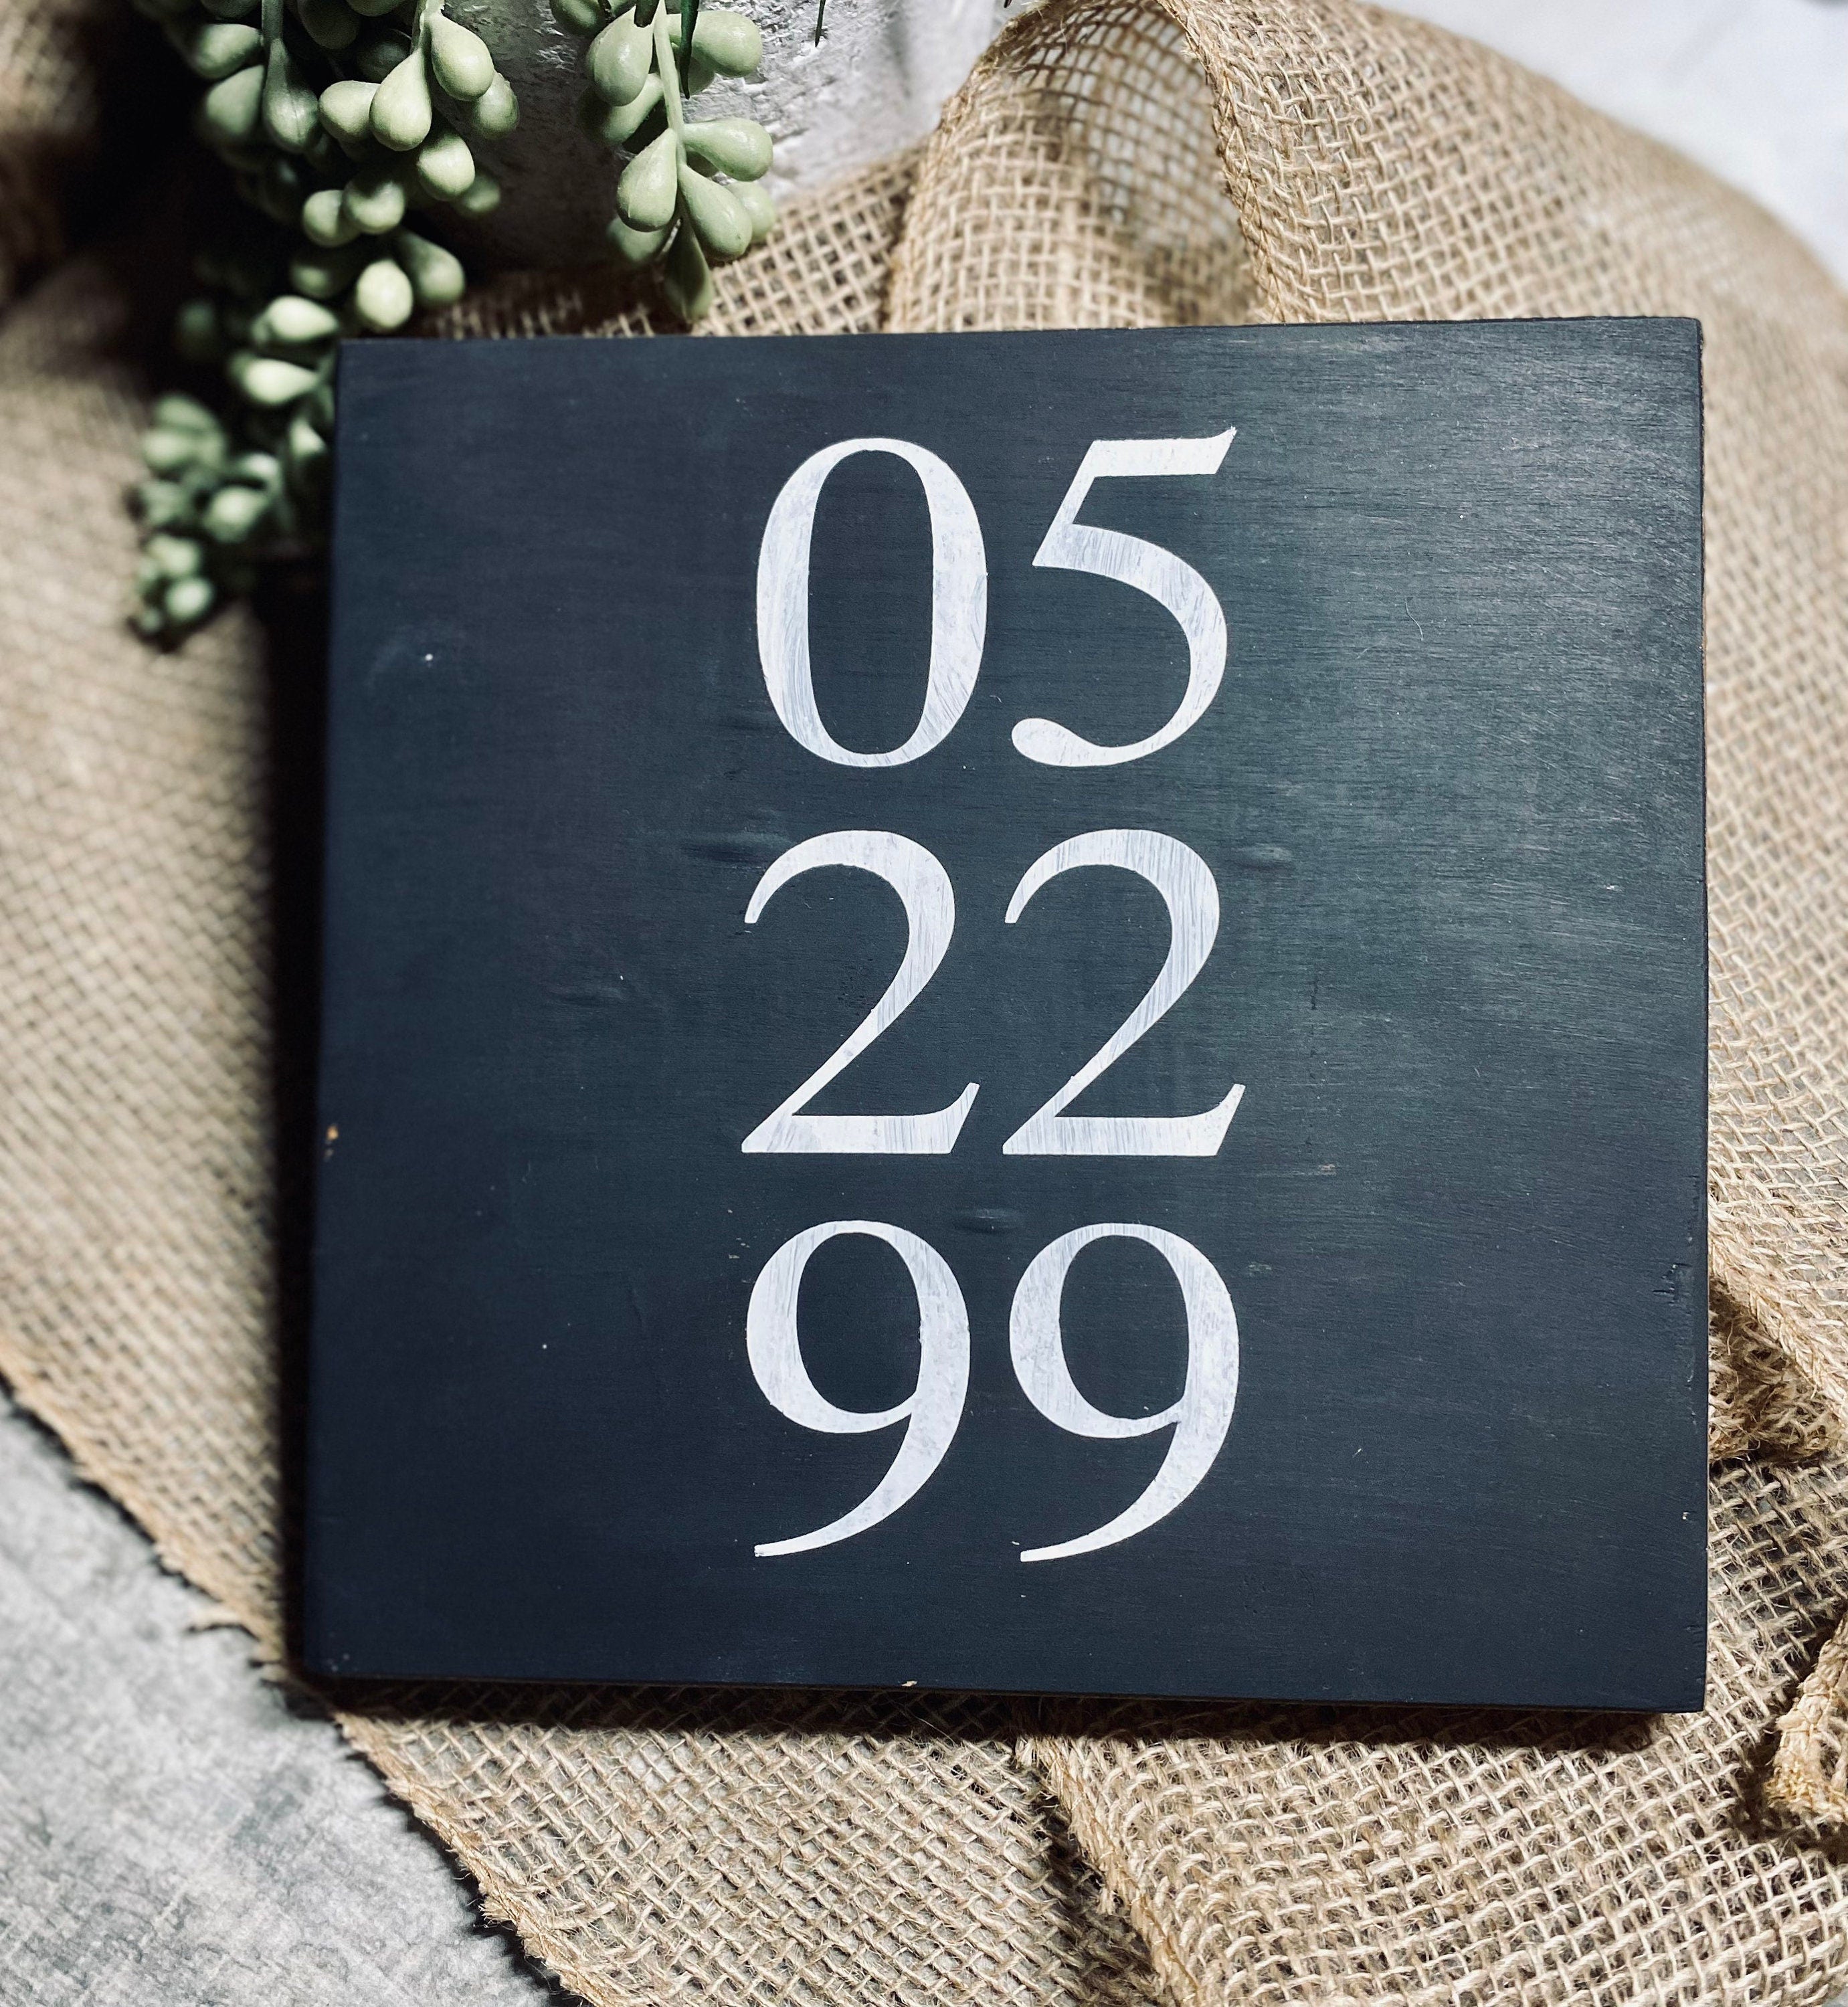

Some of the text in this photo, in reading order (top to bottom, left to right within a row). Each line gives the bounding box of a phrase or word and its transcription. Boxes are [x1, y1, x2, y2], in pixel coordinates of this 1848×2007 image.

[755, 425, 1238, 769] 05
[741, 829, 1246, 1157] 22
[745, 1220, 1240, 1563] 99
